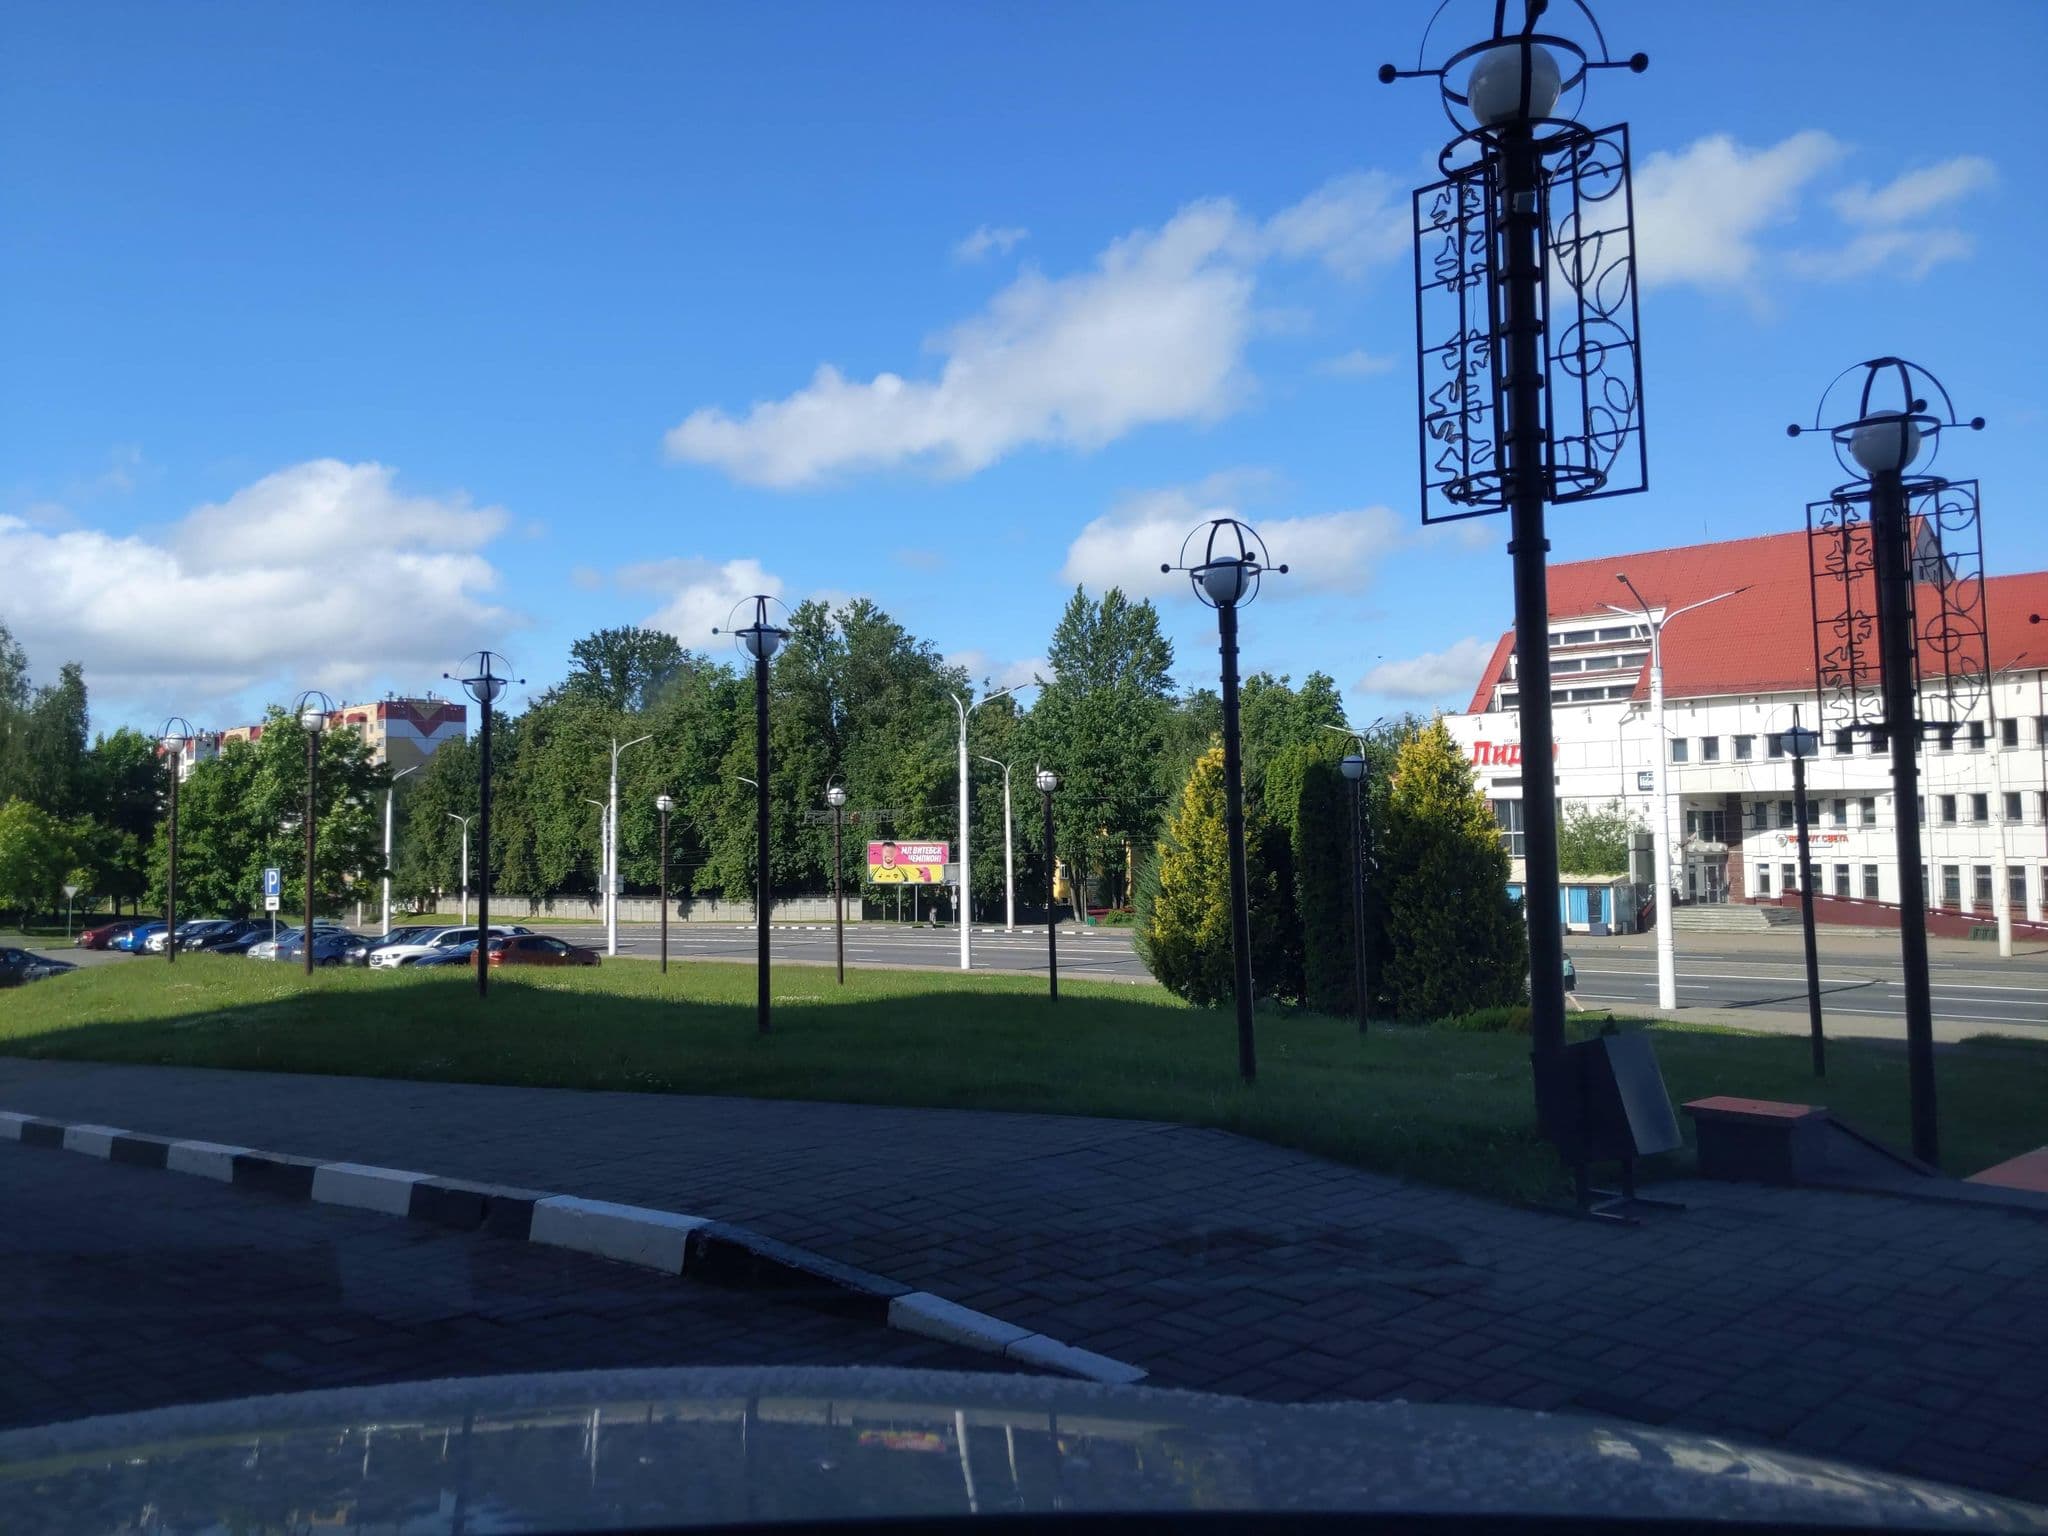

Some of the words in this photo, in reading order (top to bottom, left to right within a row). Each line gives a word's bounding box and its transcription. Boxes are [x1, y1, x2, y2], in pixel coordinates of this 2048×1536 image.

[1472, 741, 1560, 767] Лид
[912, 846, 943, 855] ВИТЕБСК
[268, 871, 277, 893] P
